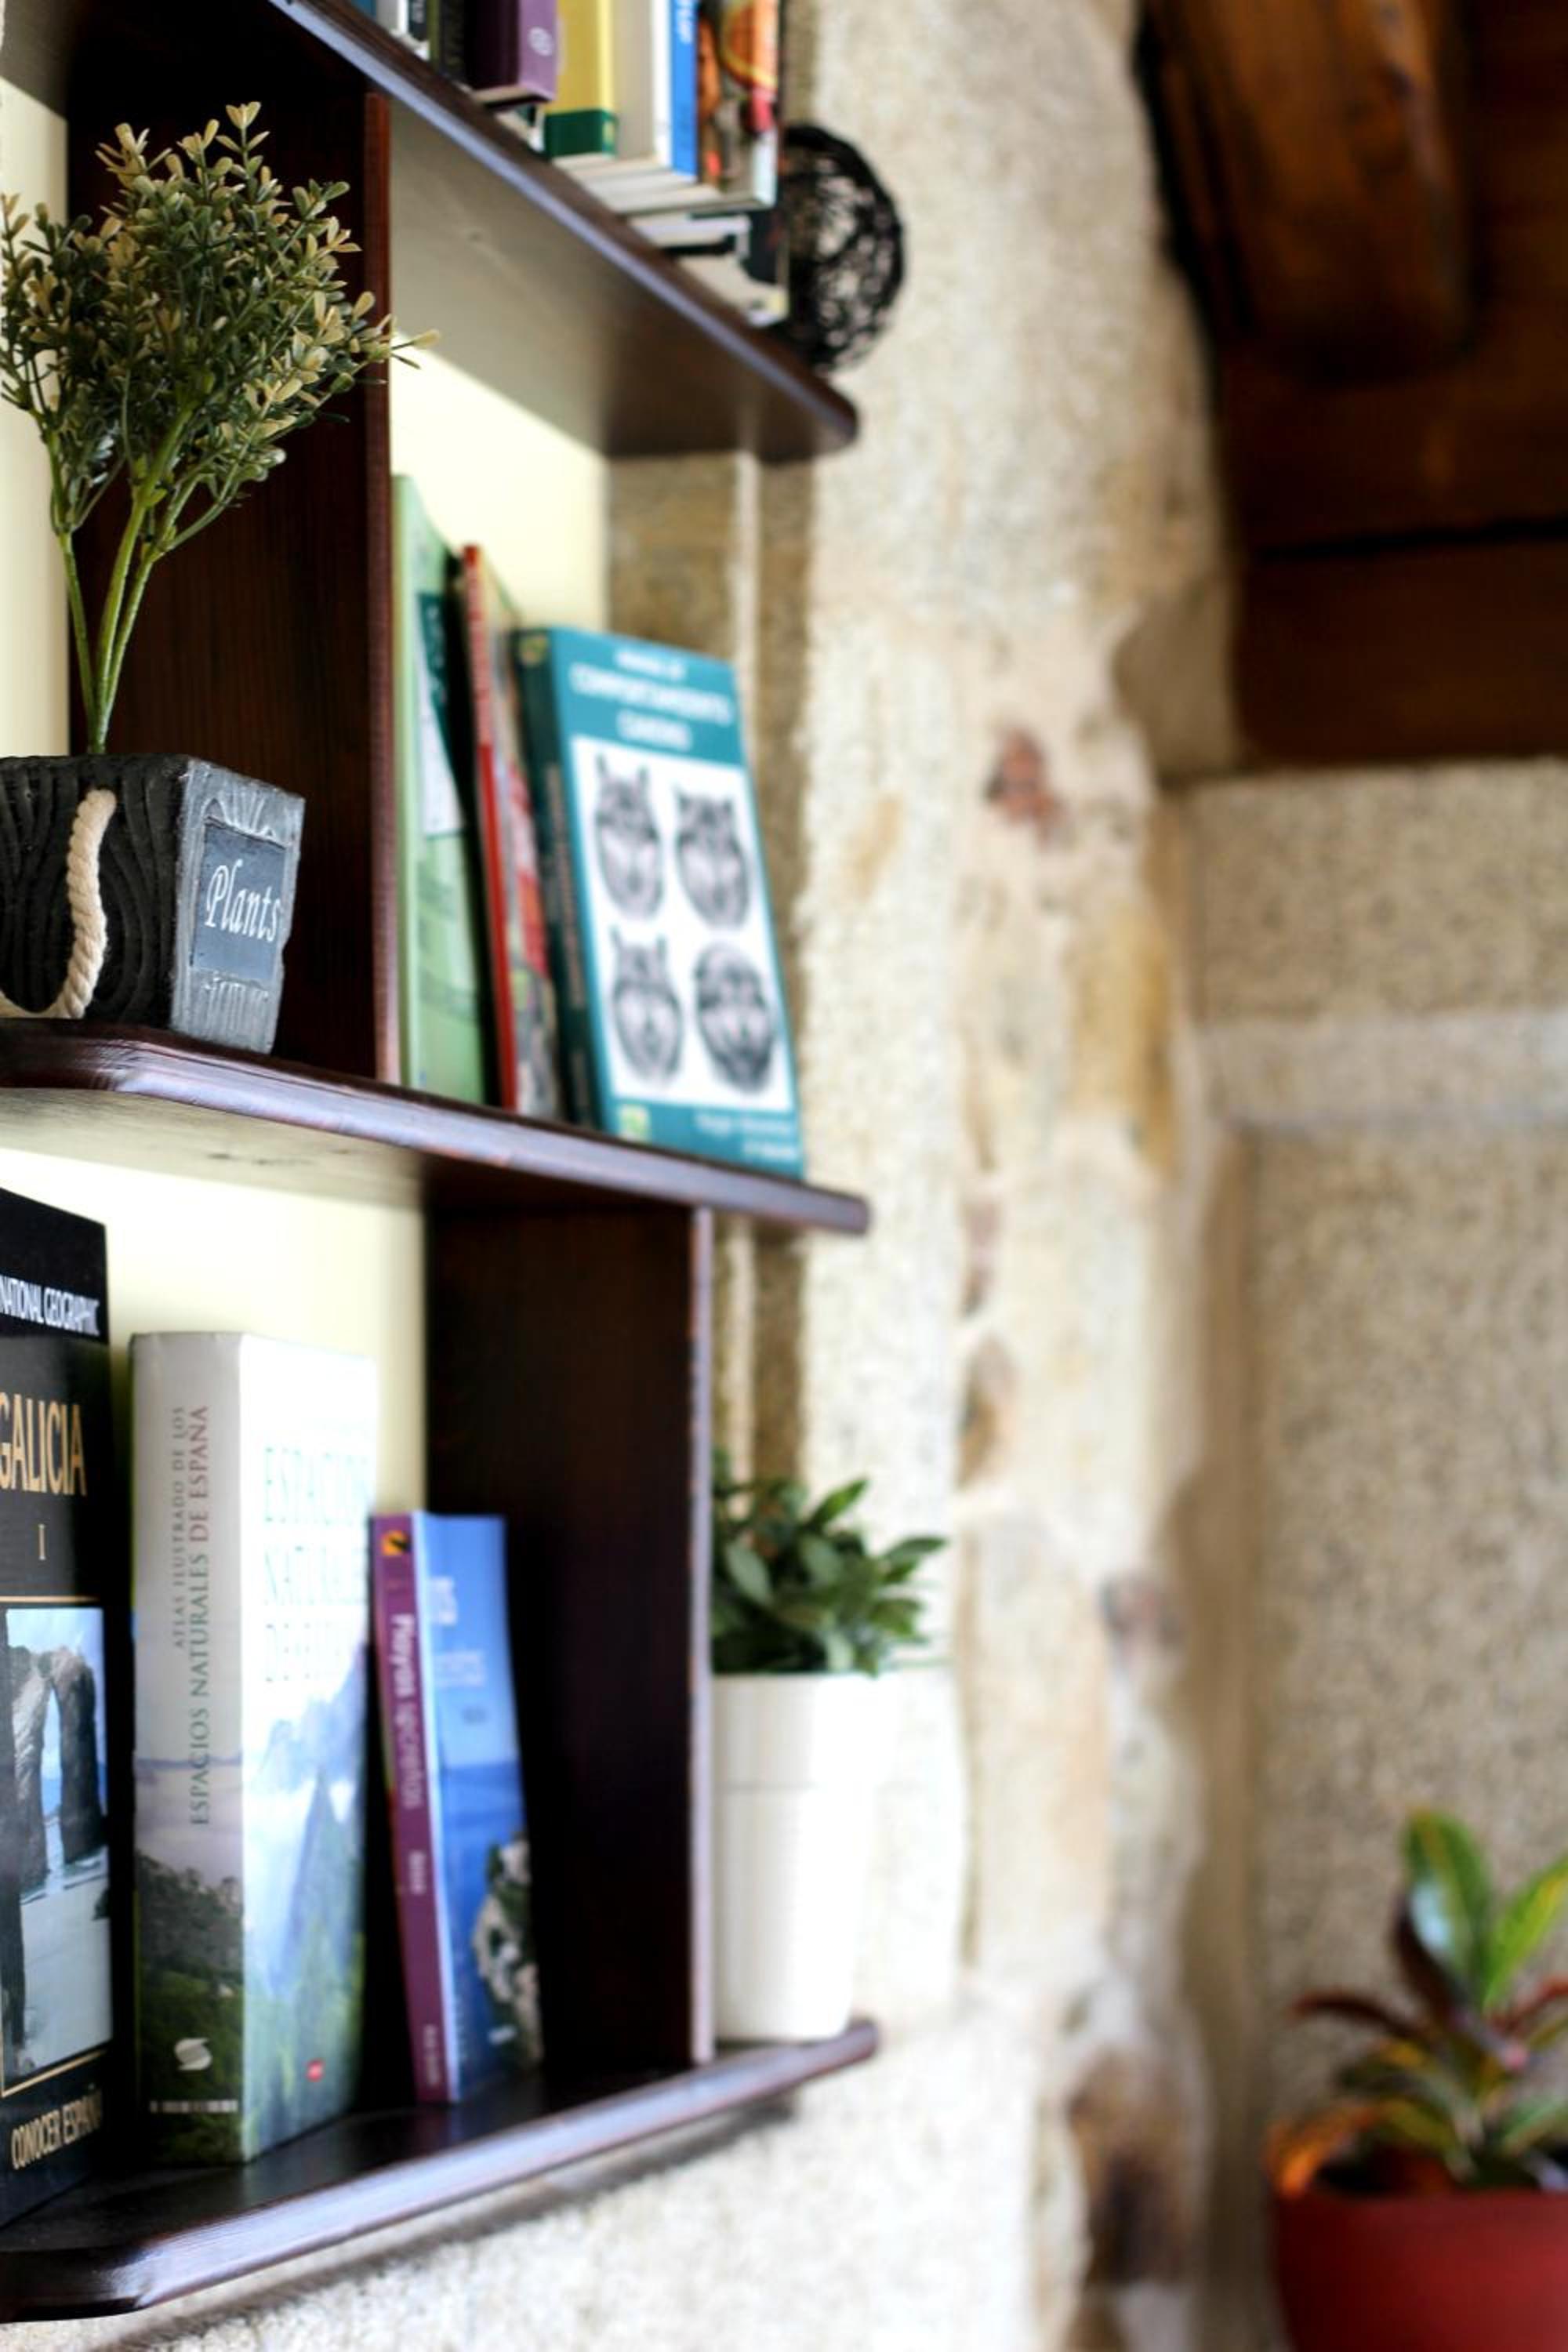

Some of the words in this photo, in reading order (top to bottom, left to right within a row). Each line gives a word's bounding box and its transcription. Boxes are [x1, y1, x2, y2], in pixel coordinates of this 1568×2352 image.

[205, 858, 284, 942] Plants
[0, 1274, 44, 1324] NATIONAL
[44, 1287, 100, 1337] GEOGRAPHIC
[0, 1392, 87, 1496] GALICIA
[172, 1406, 186, 1440] LOS
[172, 1450, 186, 1472] DE
[172, 1480, 186, 1588] ILUSTRADO
[189, 1510, 209, 1542] DE
[172, 1594, 186, 1650] ATLAS
[189, 1553, 209, 1697] NATURALES
[189, 1707, 209, 1825] ESPACIOS
[12, 2109, 62, 2170] CONOCER
